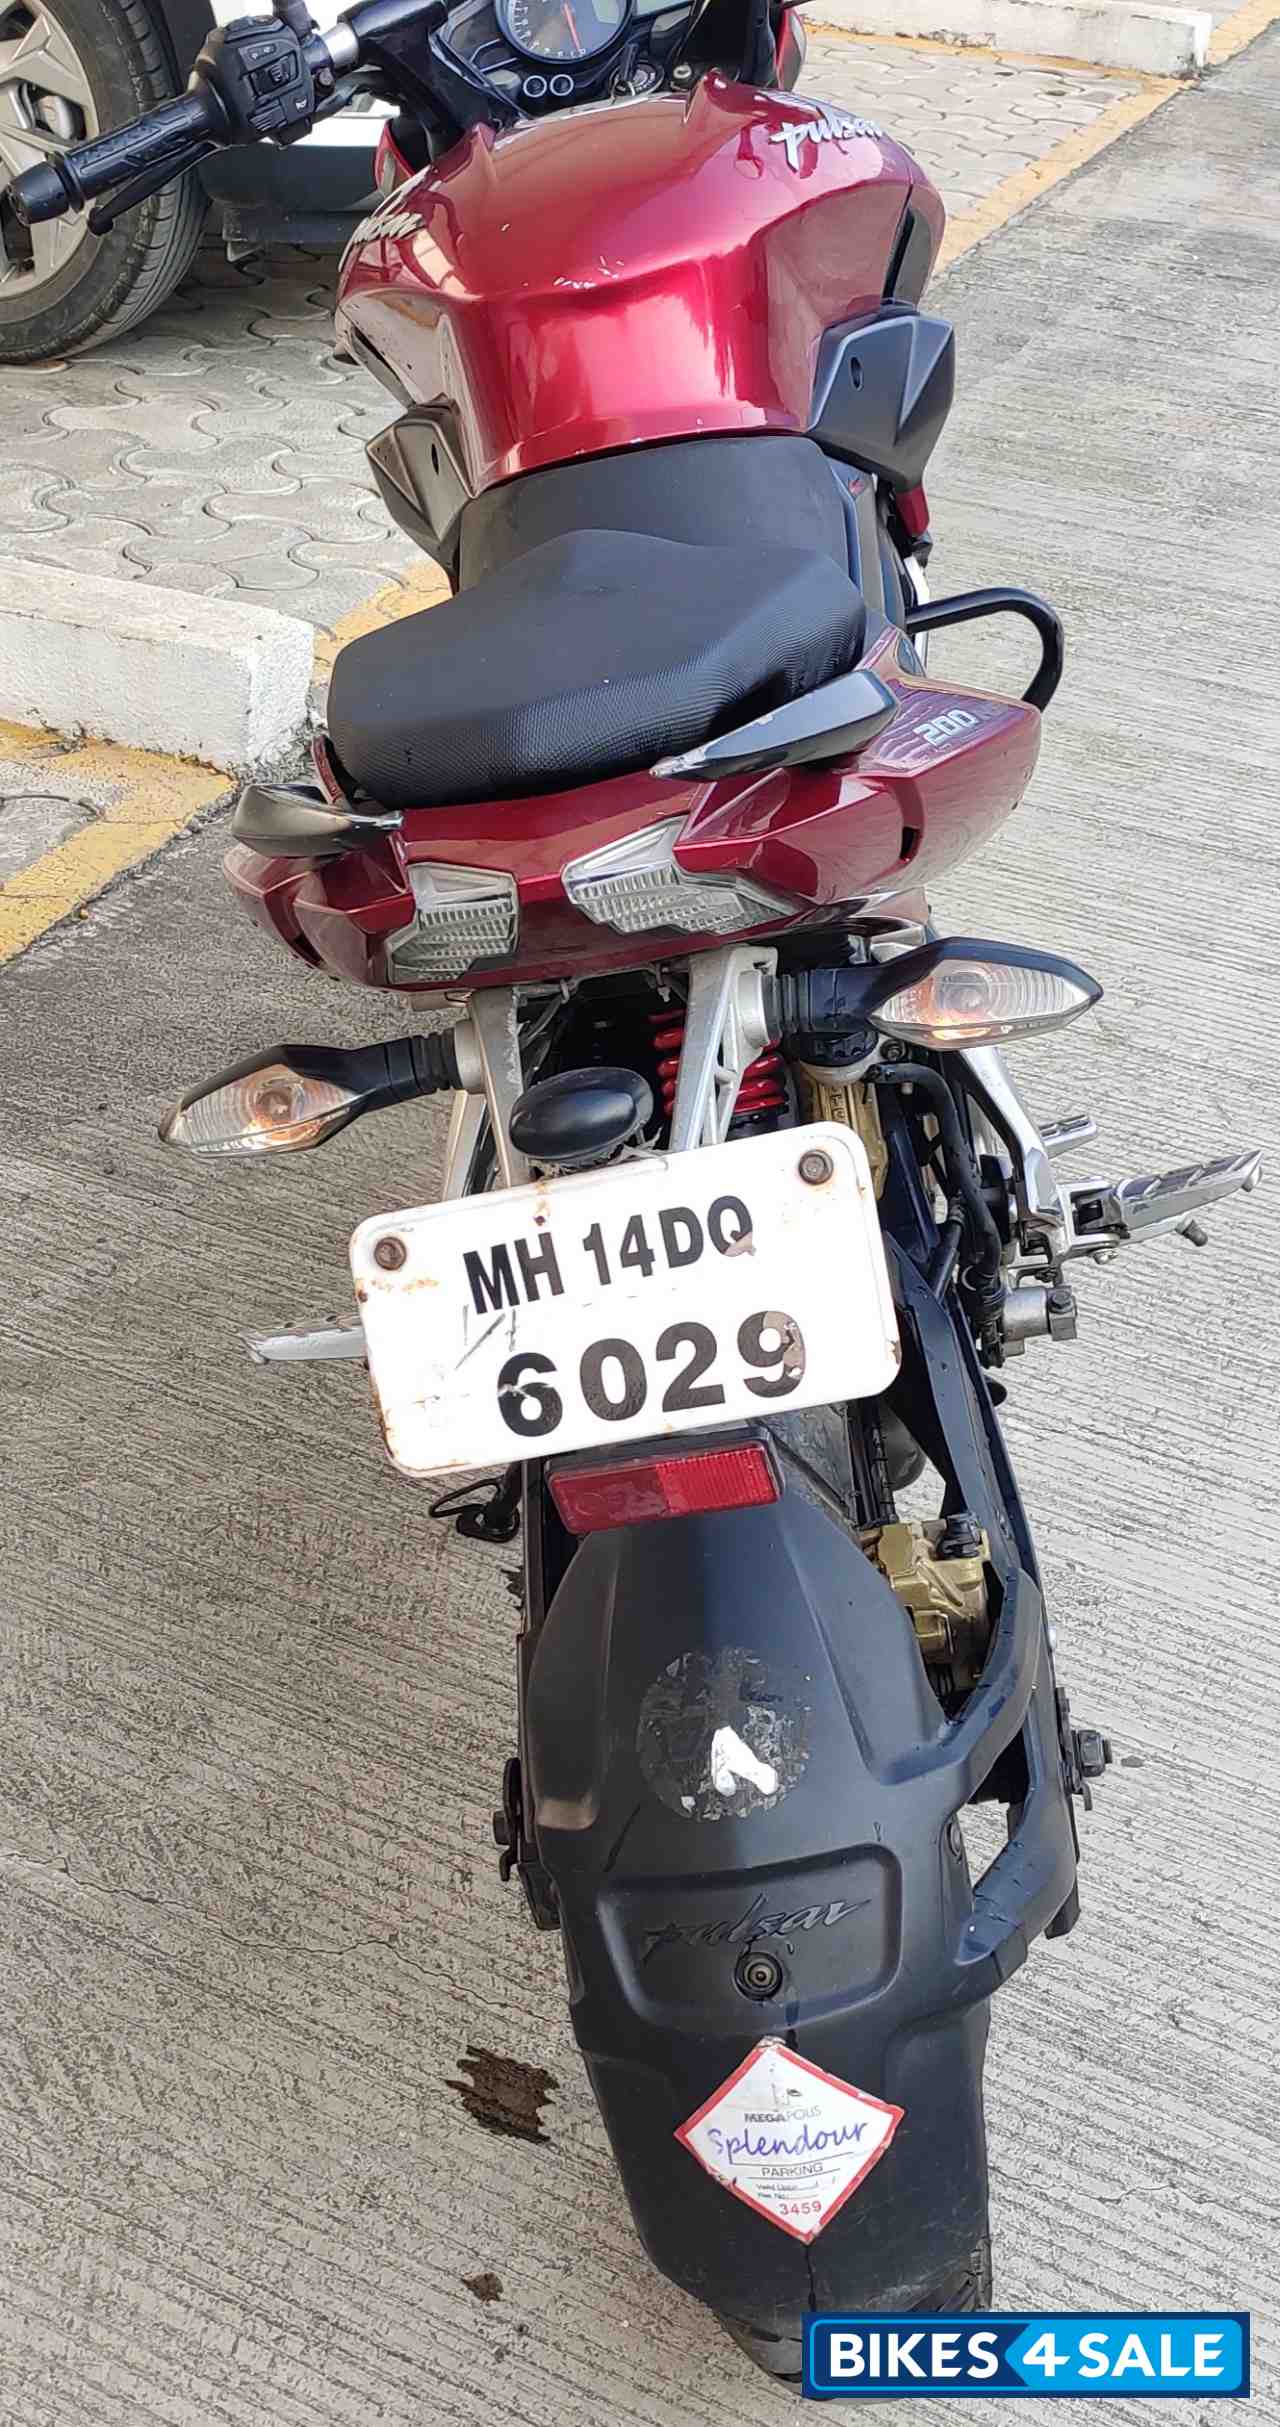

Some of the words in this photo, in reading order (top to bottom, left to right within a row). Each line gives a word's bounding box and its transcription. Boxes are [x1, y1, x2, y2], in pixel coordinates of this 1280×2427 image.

[912, 709, 980, 746] 200
[463, 1232, 564, 1314] MH
[582, 1195, 756, 1286] 14DQ
[497, 1310, 806, 1437] 6029
[707, 2122, 868, 2164] Splendour
[761, 2161, 823, 2177] PARKING
[779, 2200, 822, 2216] 3459
